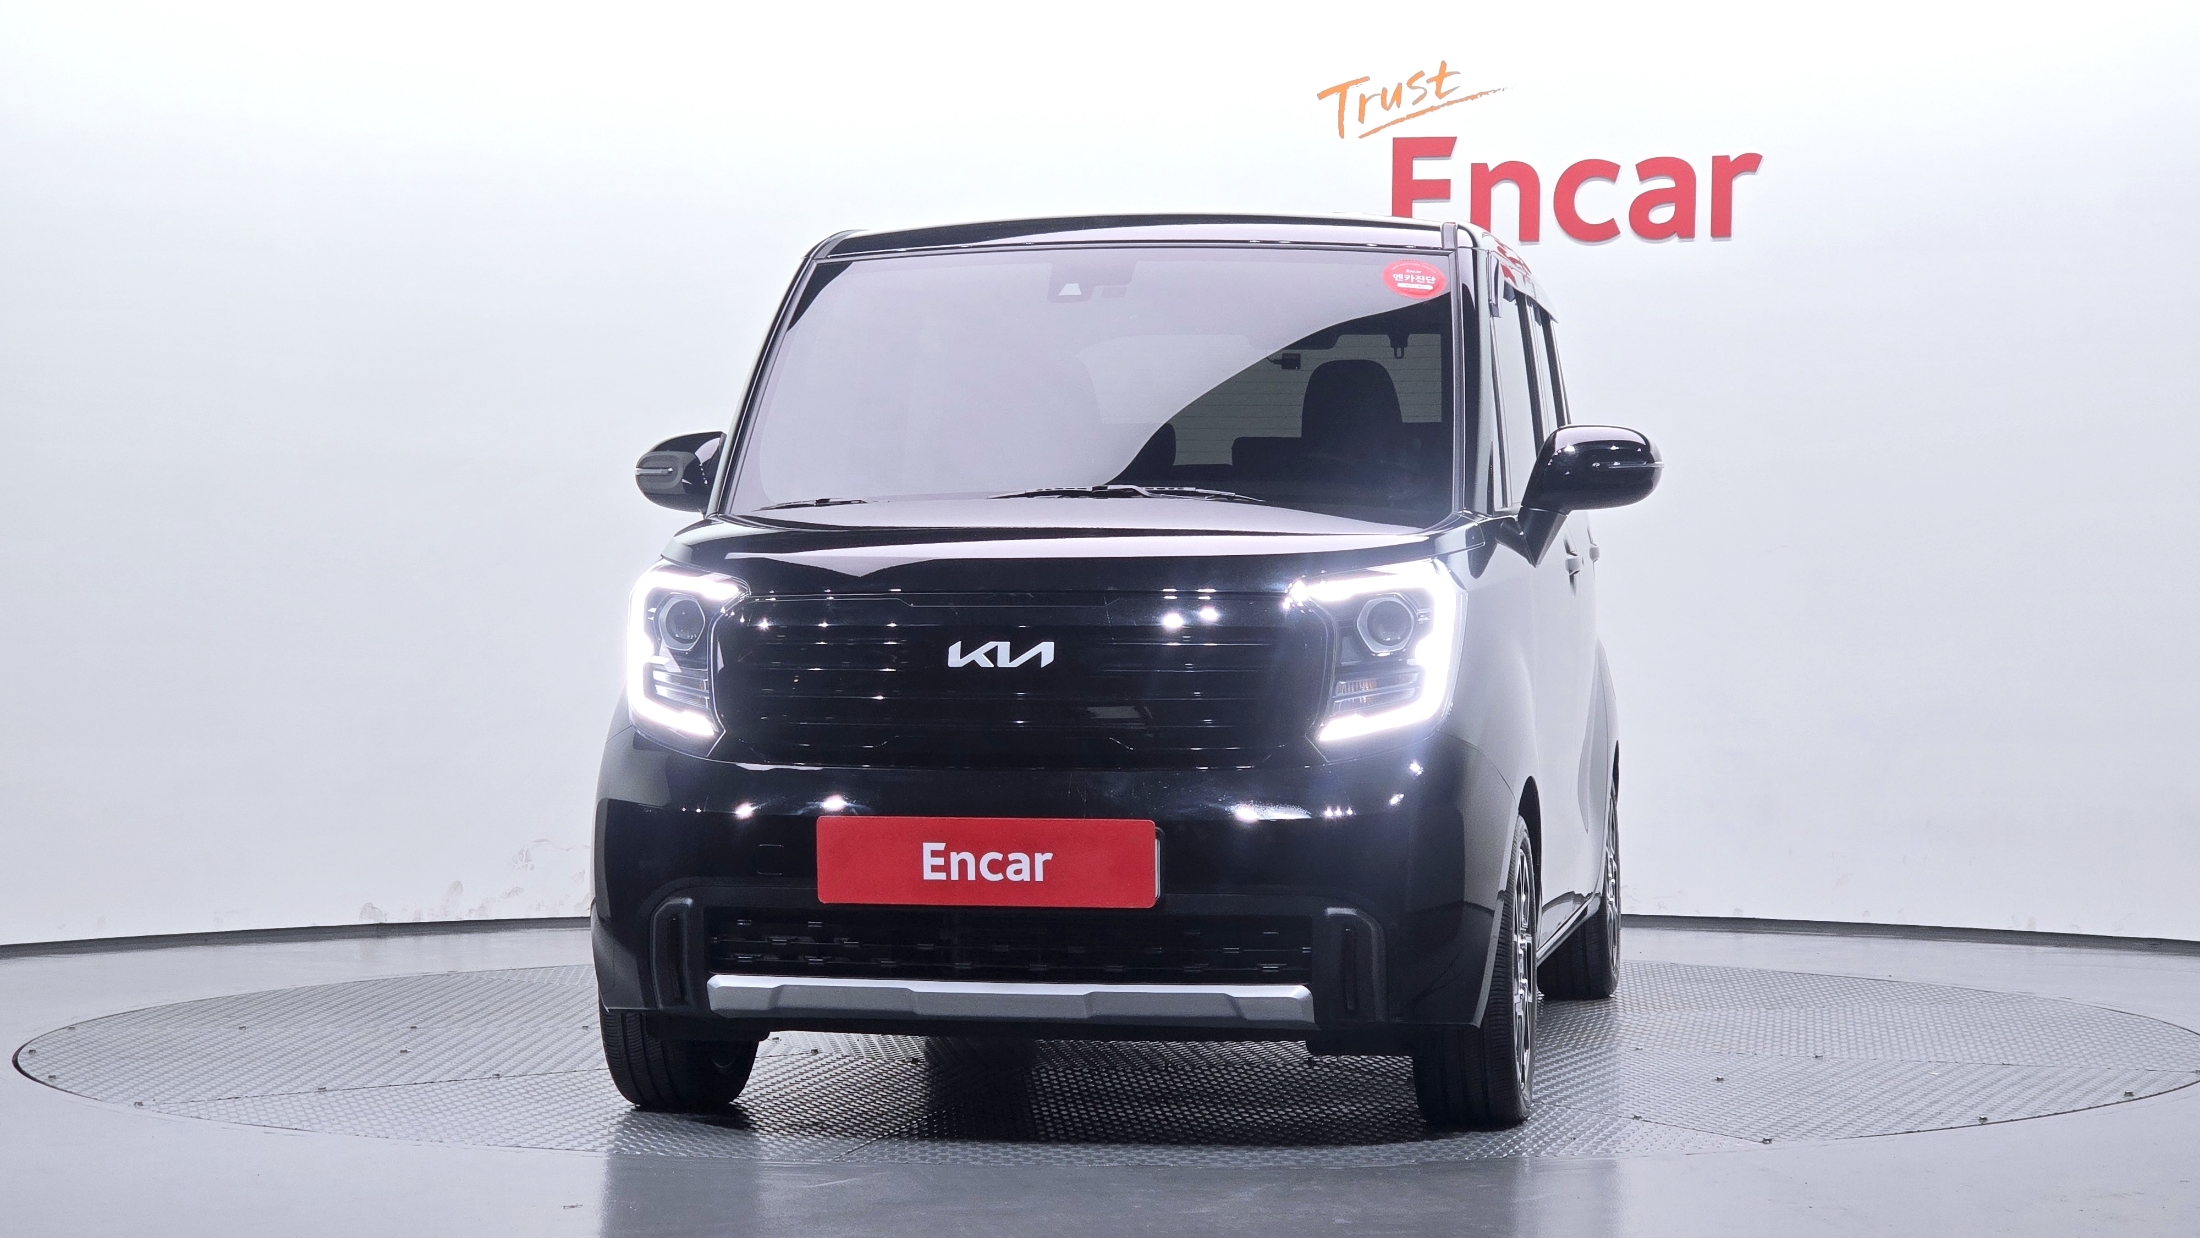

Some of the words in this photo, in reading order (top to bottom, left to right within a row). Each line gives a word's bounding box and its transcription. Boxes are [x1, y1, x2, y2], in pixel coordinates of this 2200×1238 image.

[1317, 60, 1461, 139] Trust
[1391, 136, 1764, 242] Encar
[1392, 273, 1437, 285] 엔카진단
[948, 640, 1055, 668] KIA
[921, 842, 1054, 882] Encar
